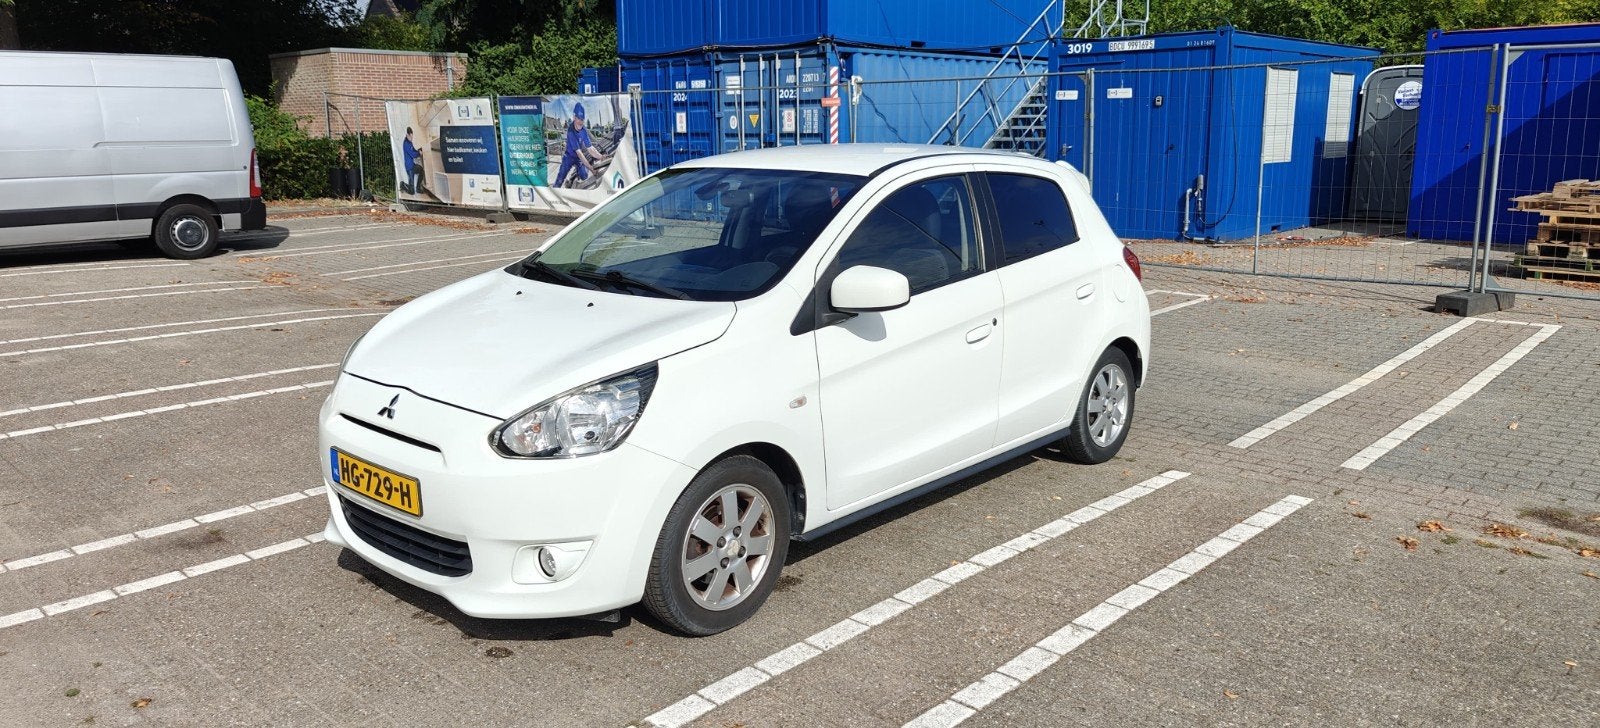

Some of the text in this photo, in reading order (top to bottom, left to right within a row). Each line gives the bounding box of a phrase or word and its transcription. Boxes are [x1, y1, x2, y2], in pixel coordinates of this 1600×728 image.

[1067, 43, 1092, 54] 3019
[802, 72, 820, 82] 220713
[340, 458, 412, 508] HG-729-H
